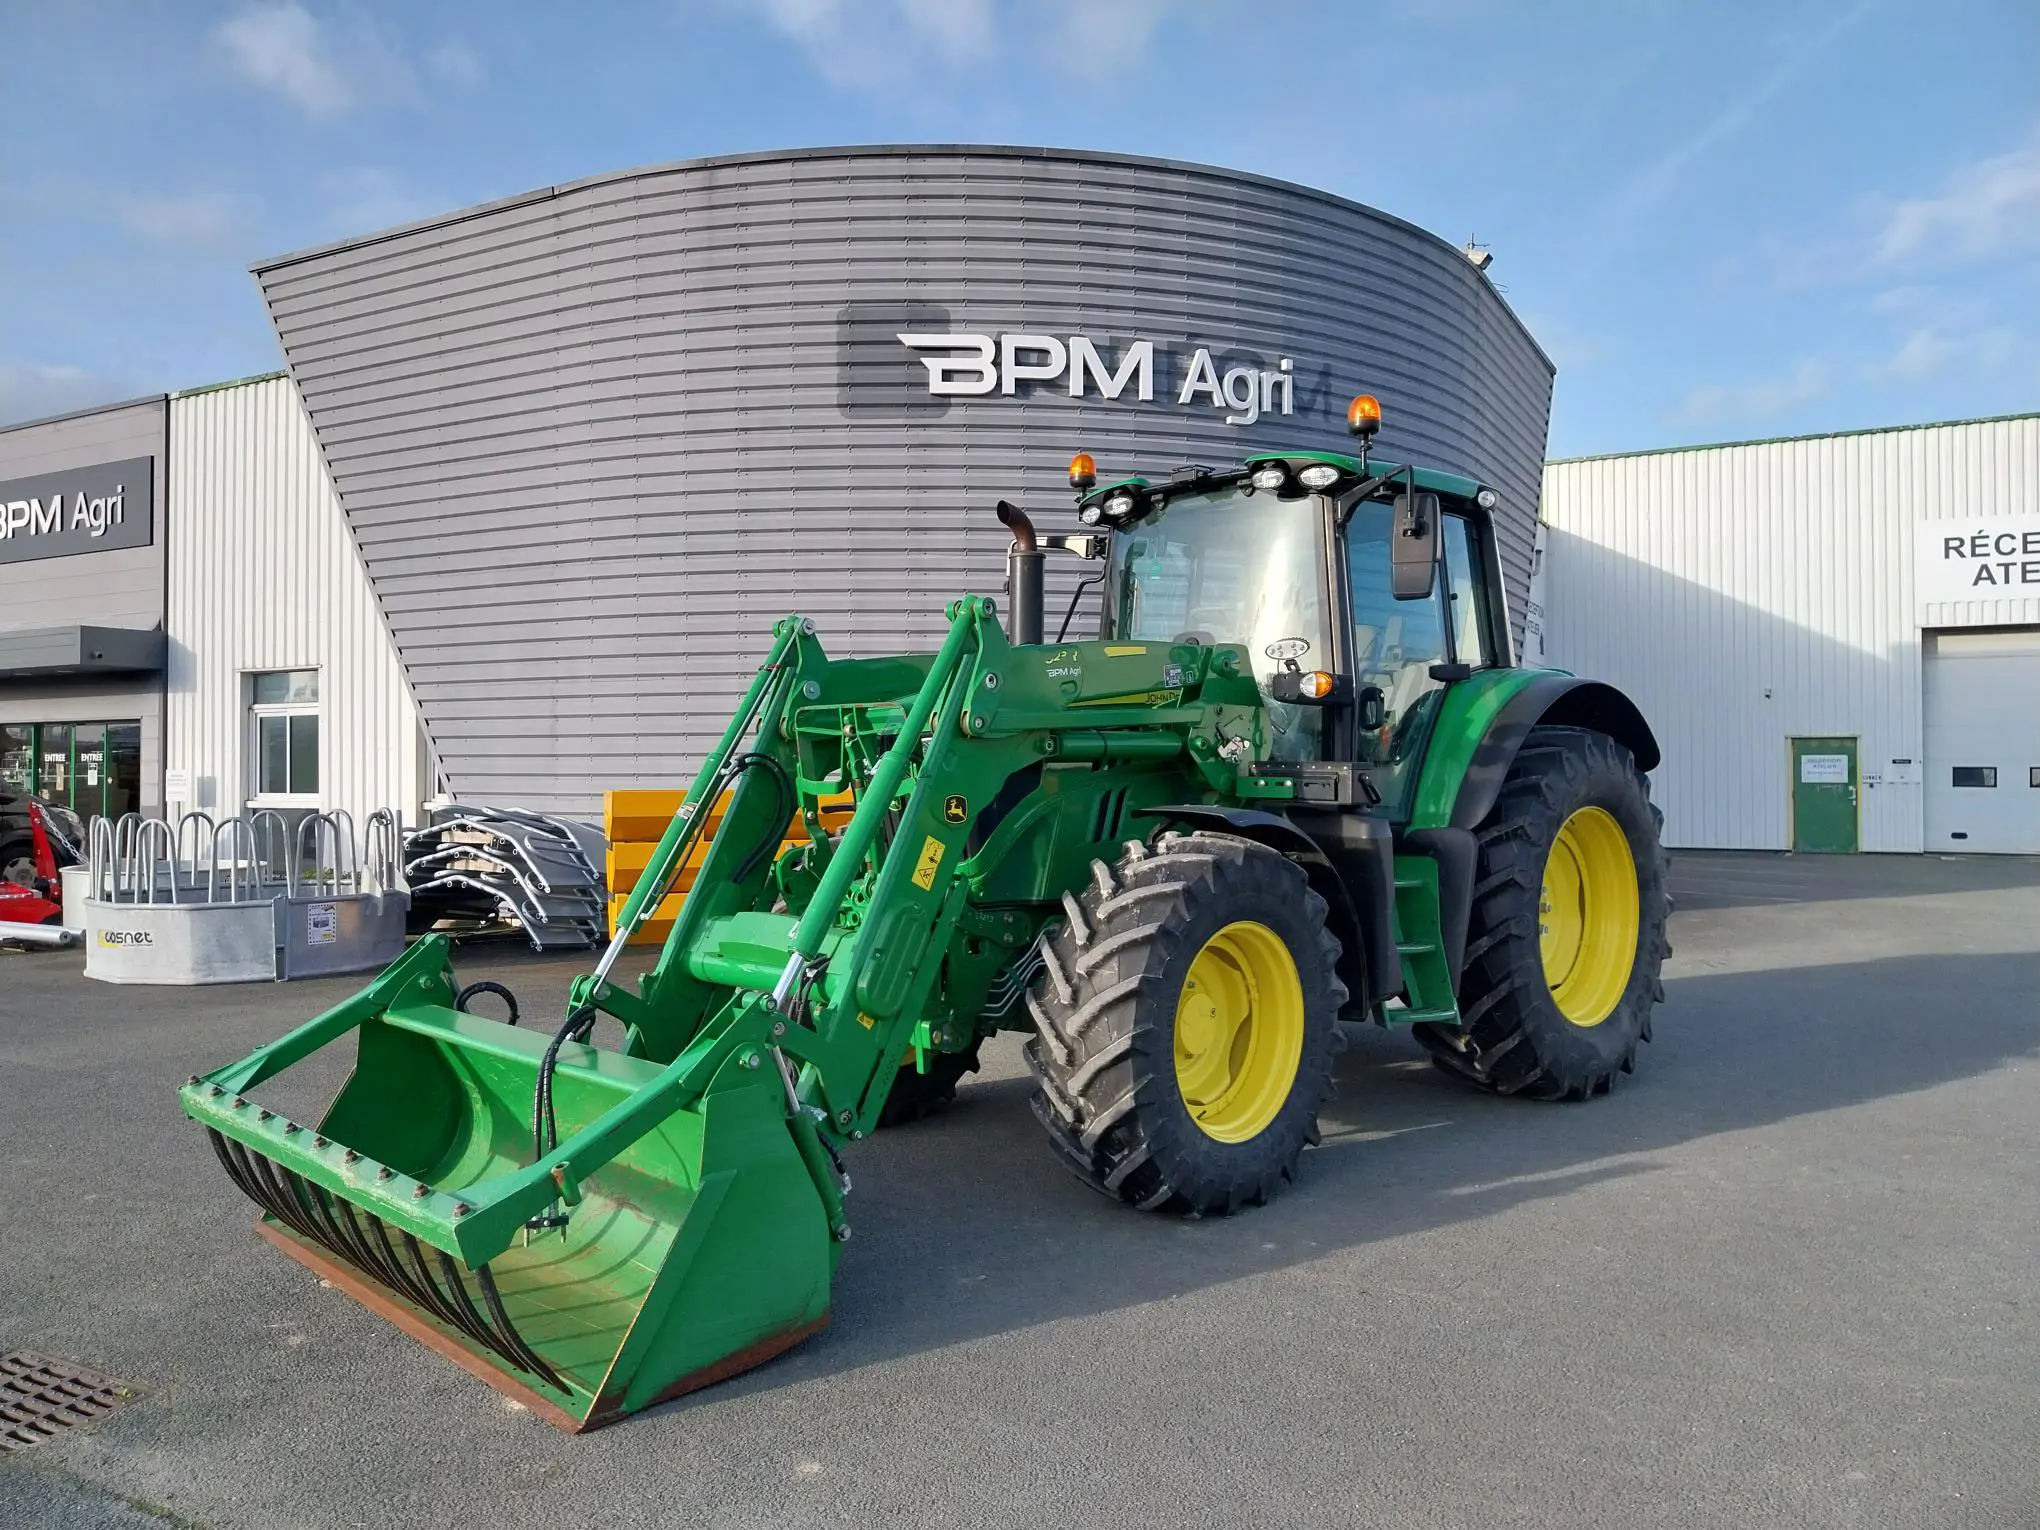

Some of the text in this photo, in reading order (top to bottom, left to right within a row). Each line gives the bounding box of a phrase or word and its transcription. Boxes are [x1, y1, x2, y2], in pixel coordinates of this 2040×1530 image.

[896, 333, 1153, 400] BPM
[1178, 348, 1293, 425] Agri
[71, 484, 125, 537] Agri
[1943, 529, 2040, 559] RÉCE
[1972, 561, 2040, 586] ATE
[1046, 667, 1068, 677] BPM
[1146, 692, 1169, 703] JOHN
